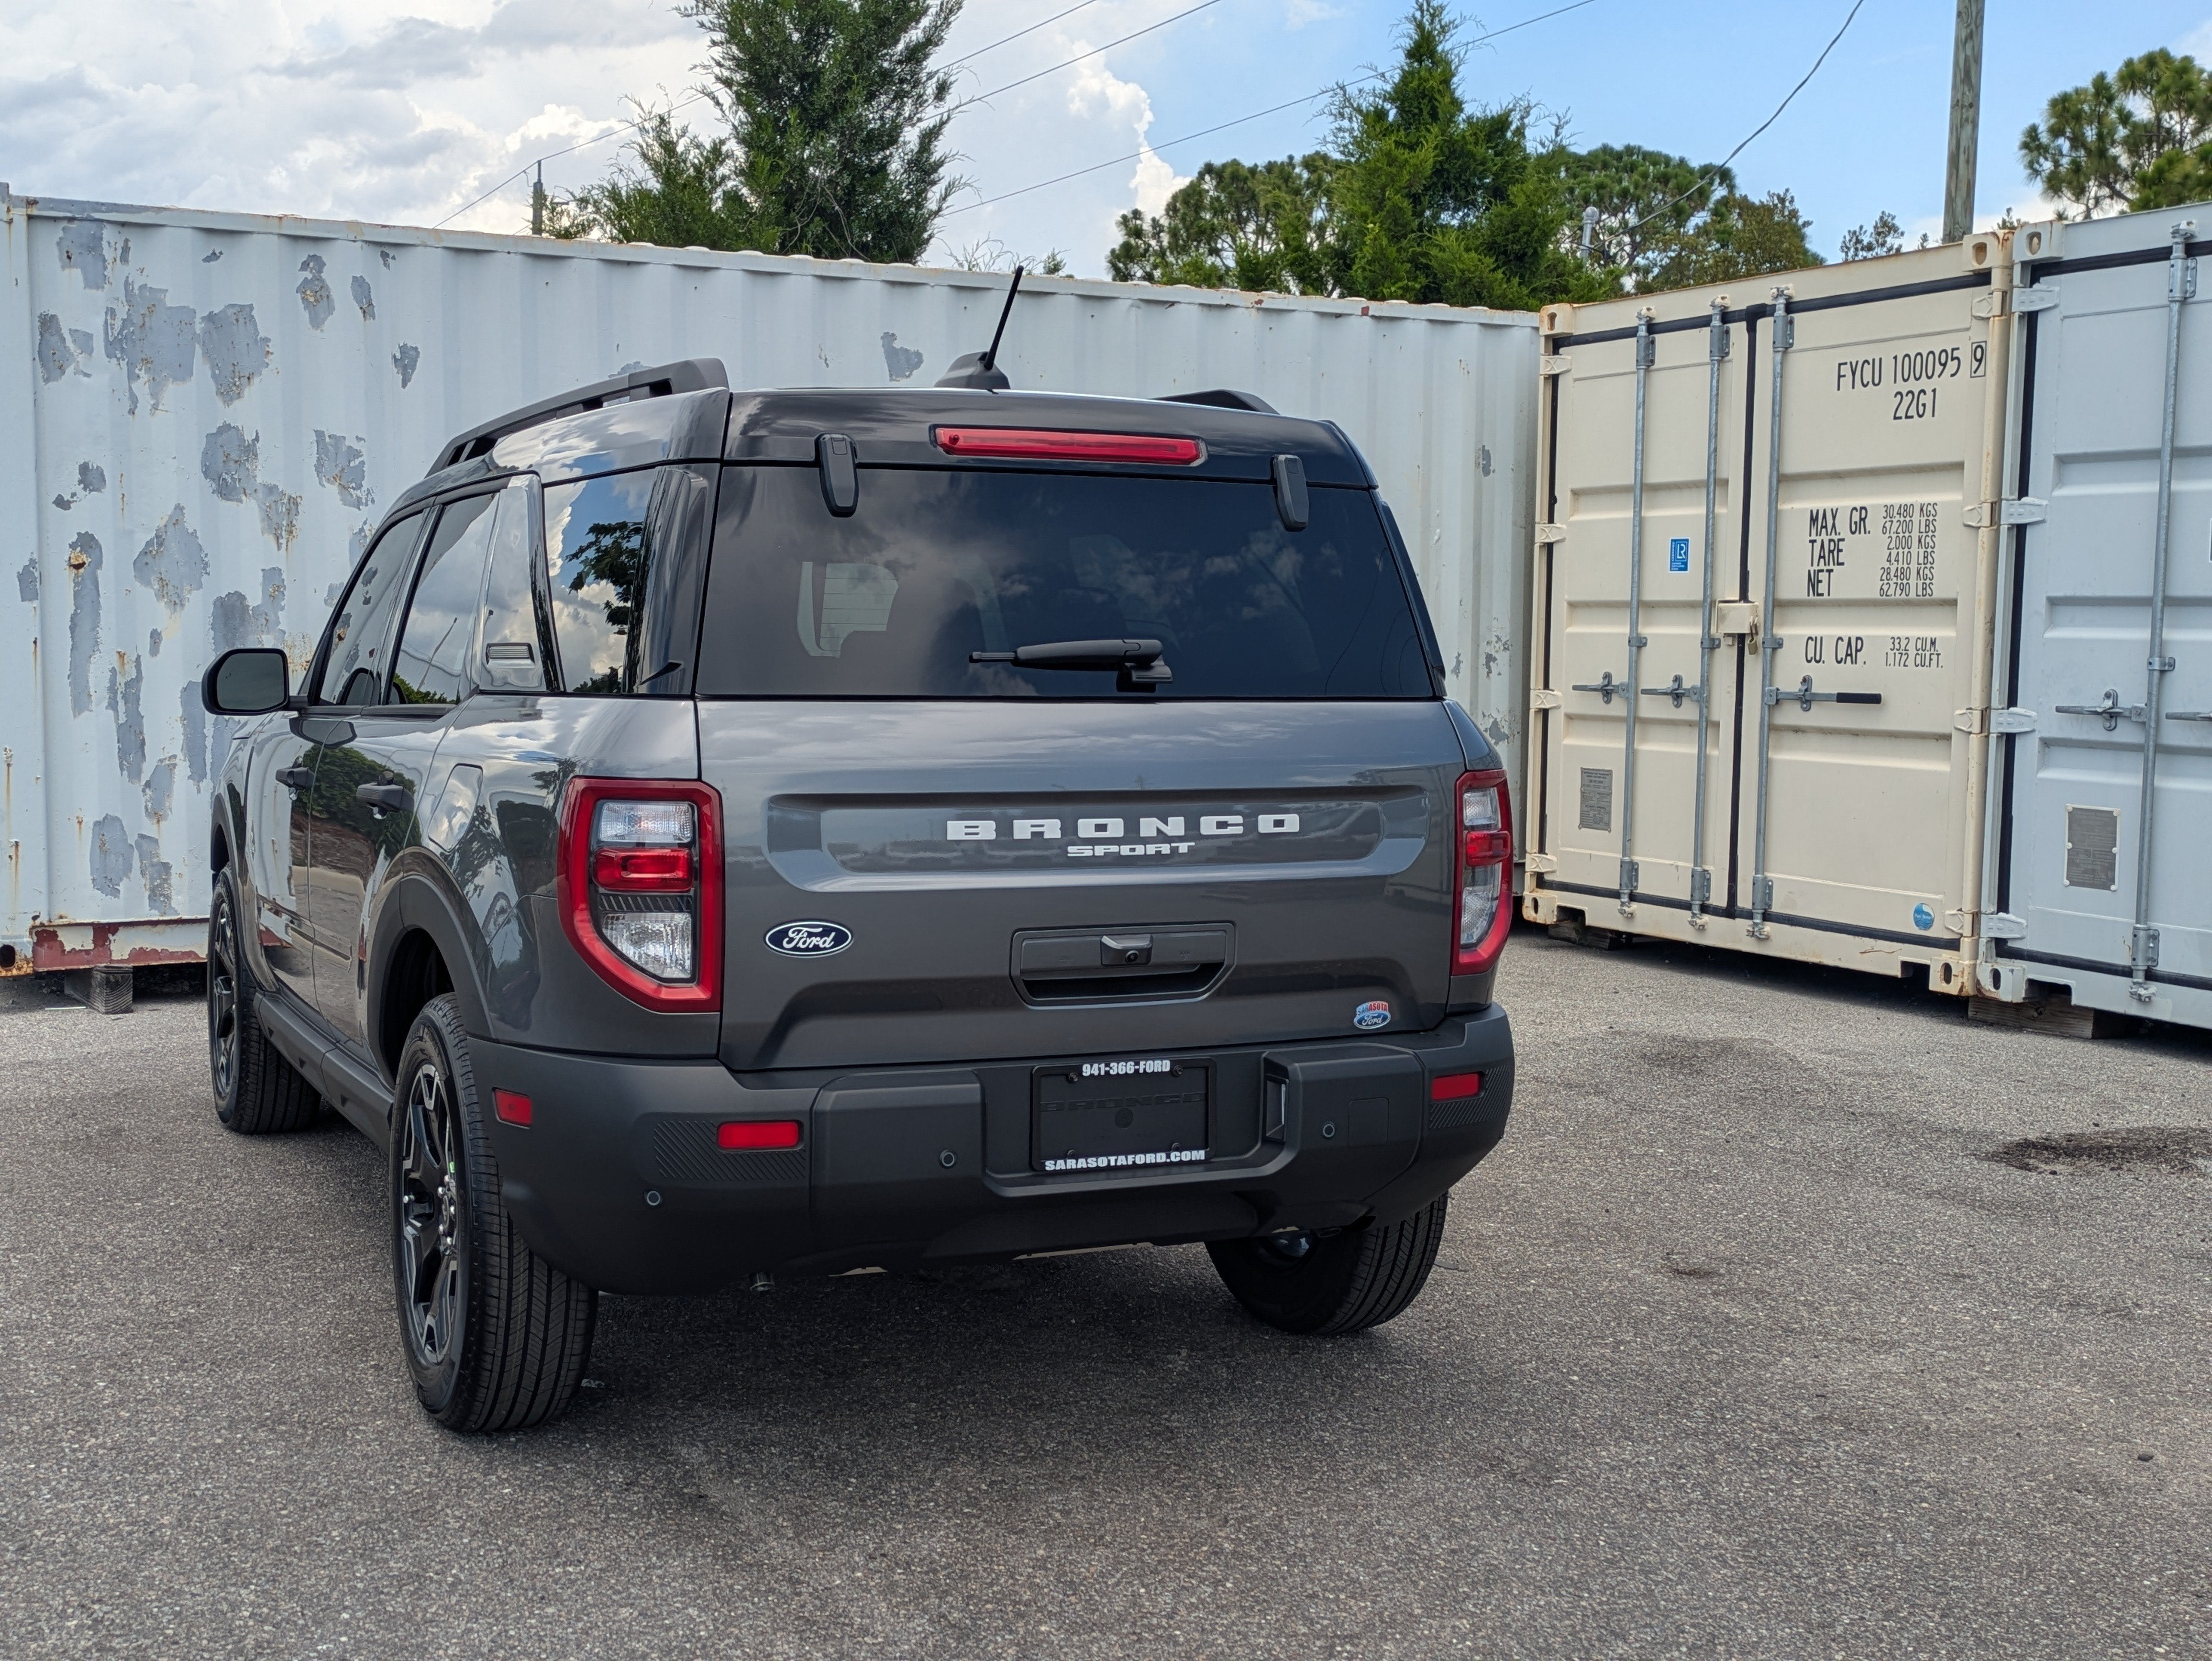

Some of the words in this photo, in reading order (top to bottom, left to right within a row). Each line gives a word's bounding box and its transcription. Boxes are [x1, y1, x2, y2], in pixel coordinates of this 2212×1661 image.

[1836, 357, 1882, 391] FYCU
[1892, 347, 1961, 384] 100095
[1973, 344, 1984, 374] 9
[1893, 388, 1936, 420] 22G1
[1919, 502, 1937, 518] KGS
[1809, 508, 1841, 537] MAX.
[1849, 506, 1870, 535] GR.
[1918, 519, 1936, 533] LBS
[1917, 534, 1936, 549] KGS
[1809, 538, 1845, 567] TARE
[1917, 550, 1935, 565] LBS
[1916, 566, 1935, 581] KGS
[1807, 568, 1834, 597] NET
[1916, 582, 1934, 597] LBS
[1805, 636, 1825, 664] CU.
[1835, 636, 1866, 665] CAP.
[1890, 636, 1910, 651] 33.2
[946, 813, 1300, 841] BRONCO
[1067, 842, 1195, 857] SPORT
[782, 927, 836, 949] Ford
[1357, 1002, 1388, 1016] SARASOTA
[1362, 1013, 1383, 1025] Ford
[1082, 1059, 1171, 1076] 941-366-FORD
[1045, 1150, 1206, 1171] SARASOTAFORD.COM
